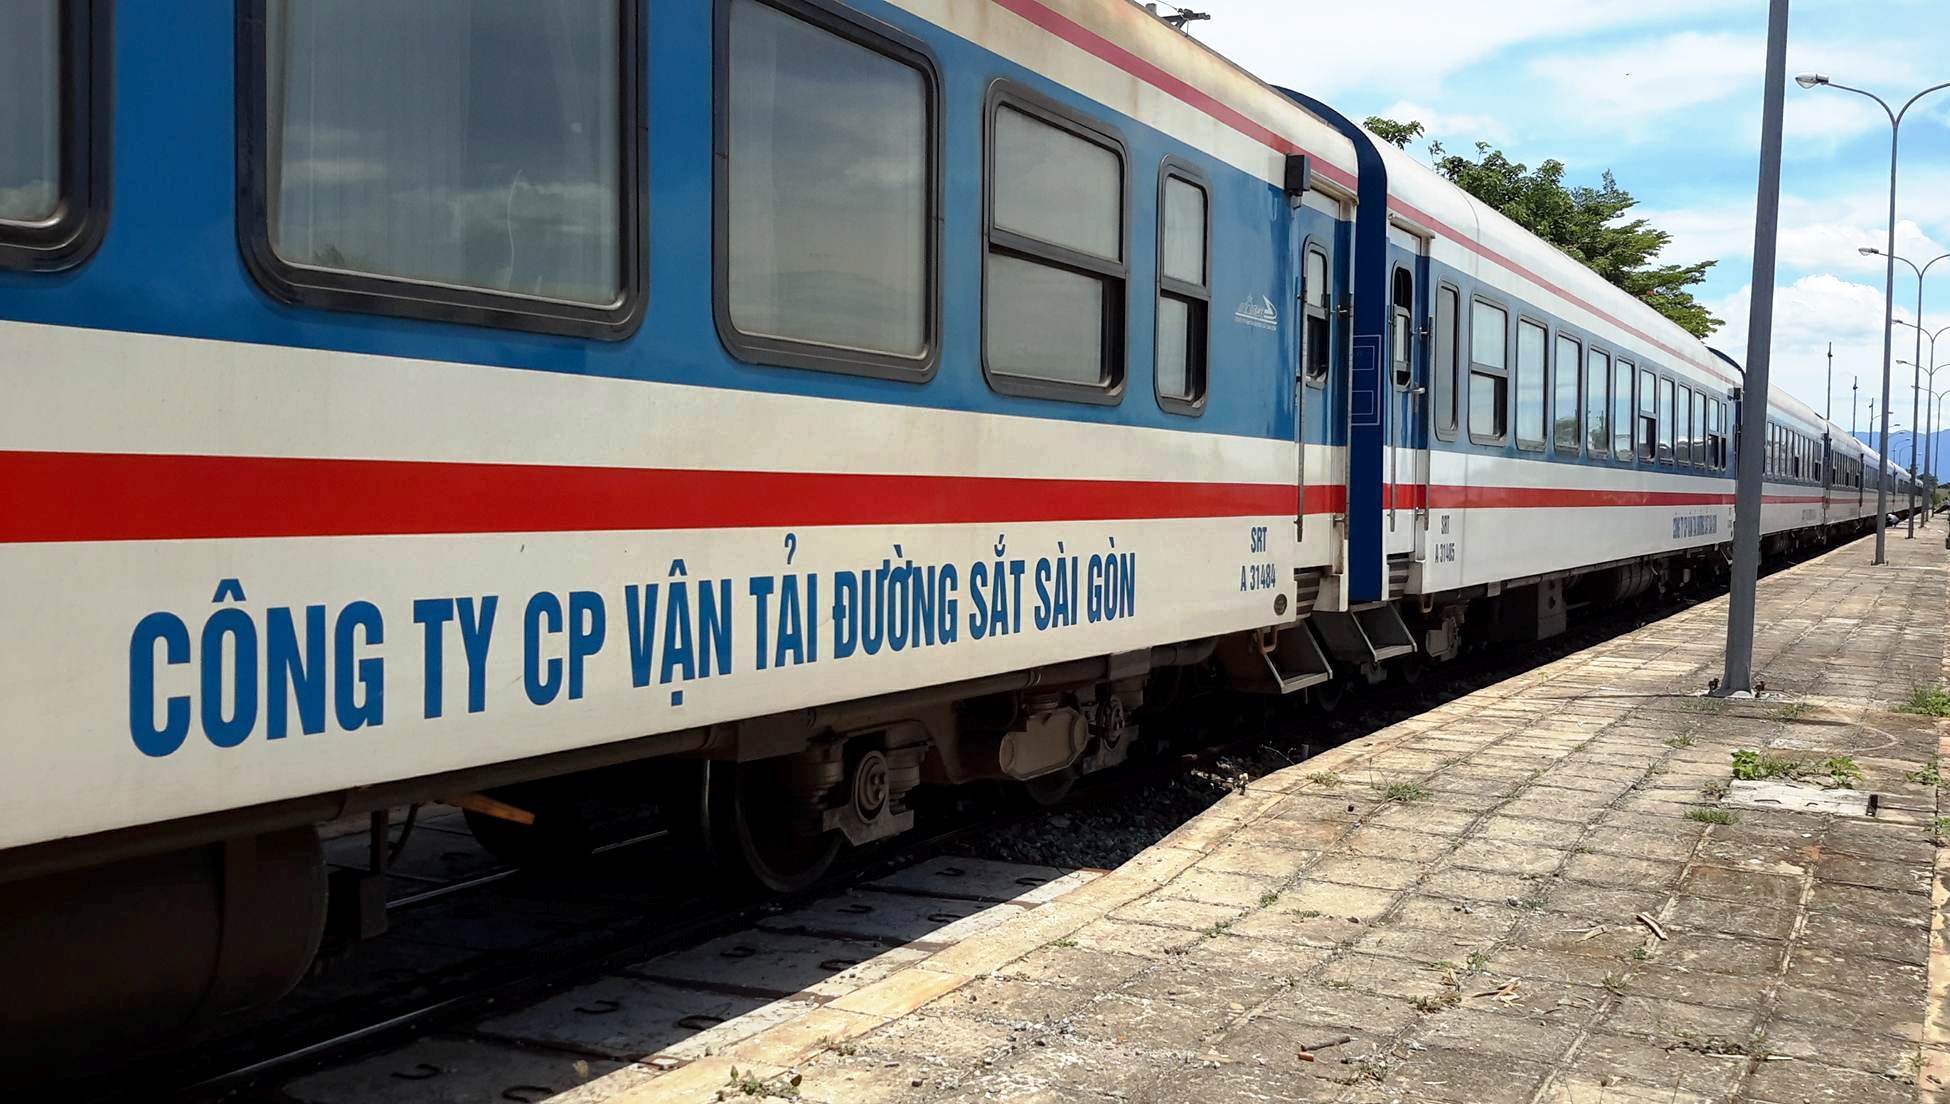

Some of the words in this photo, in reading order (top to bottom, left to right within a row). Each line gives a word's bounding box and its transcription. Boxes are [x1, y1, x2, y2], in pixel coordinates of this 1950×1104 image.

[1250, 526, 1268, 553] SRT
[1240, 565, 1247, 591] A
[1250, 563, 1276, 591] 31484
[129, 578, 385, 757] CÔNG
[413, 595, 499, 719] TY
[523, 590, 606, 705] CP
[624, 559, 732, 706] VẬN
[748, 533, 818, 670] TẢI
[832, 544, 958, 659] ĐƯỜNG
[969, 534, 1025, 640] SẮT
[1034, 541, 1078, 631] SÀI
[1087, 537, 1136, 622] GÒN
